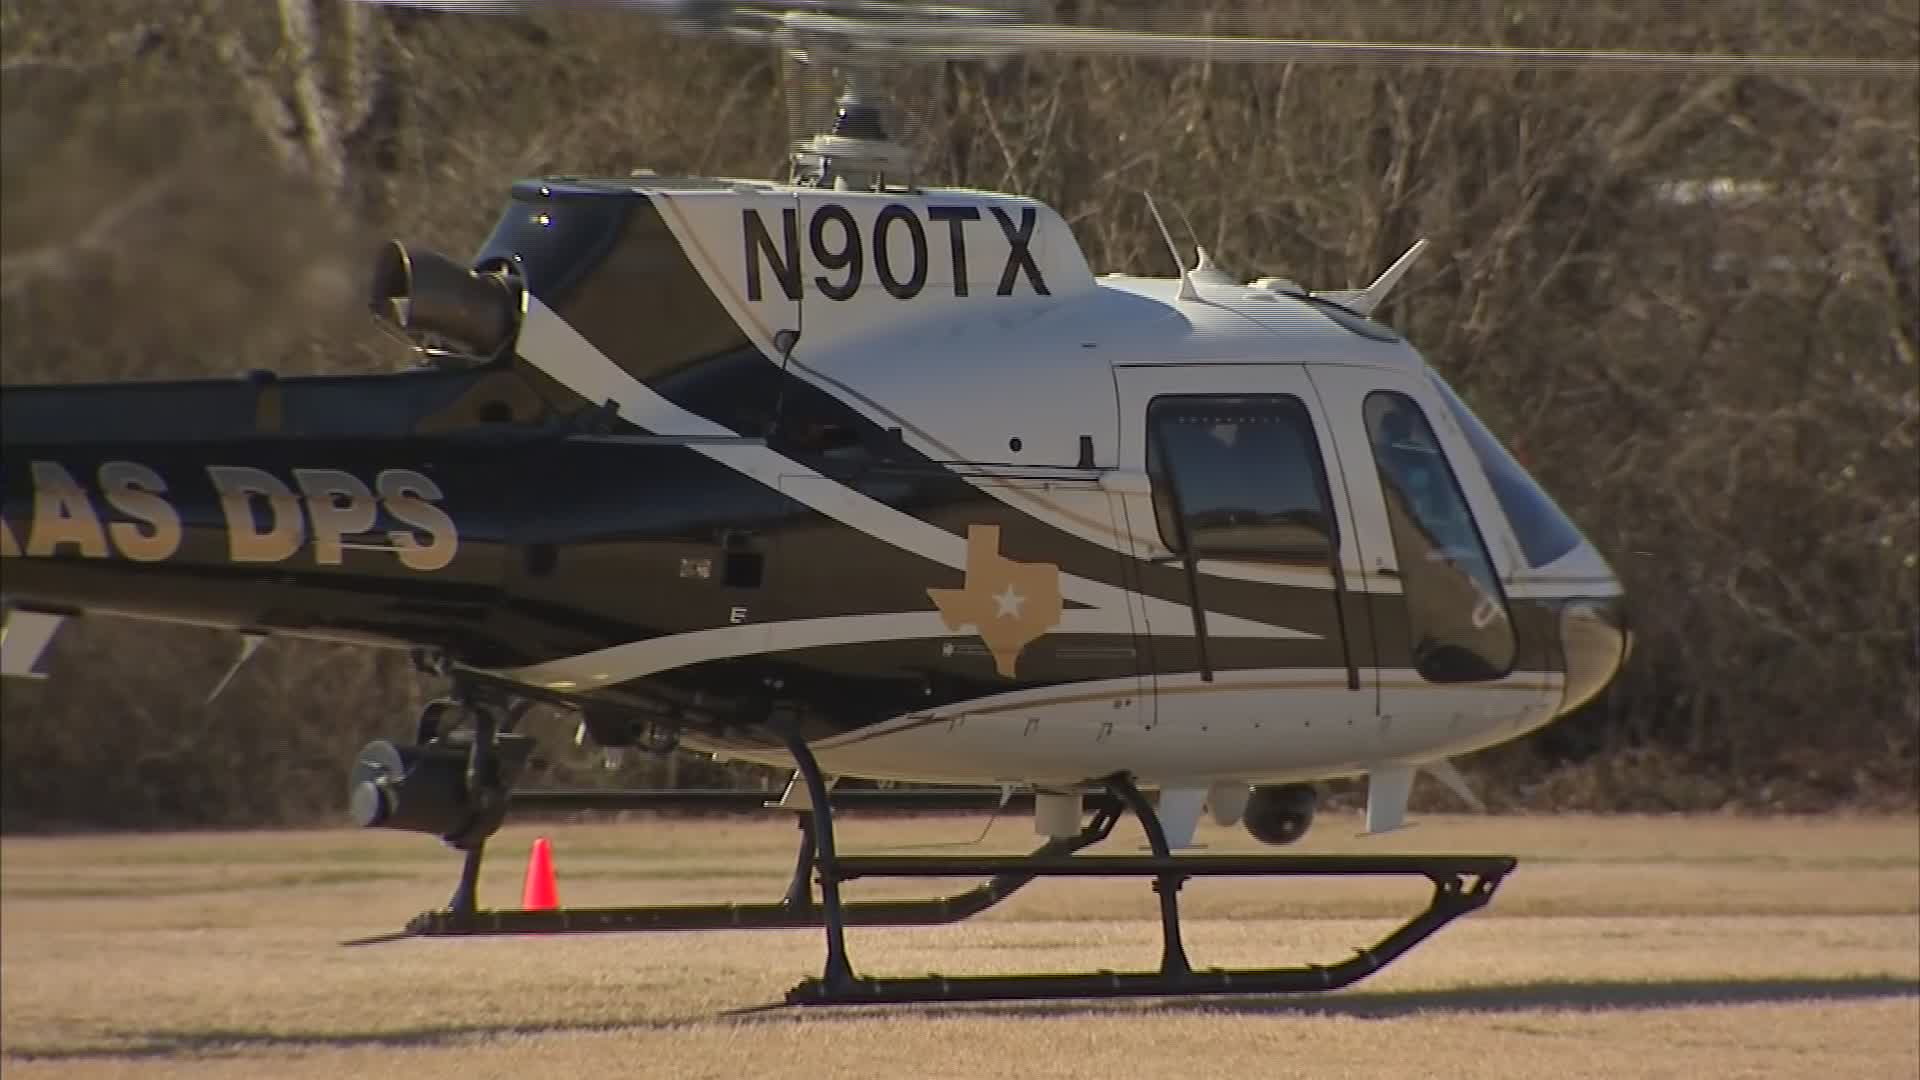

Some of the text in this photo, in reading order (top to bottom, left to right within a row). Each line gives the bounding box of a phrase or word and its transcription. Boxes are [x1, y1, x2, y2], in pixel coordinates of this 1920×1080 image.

[742, 203, 1052, 301] N90TX
[0, 460, 459, 571] AS DPS
